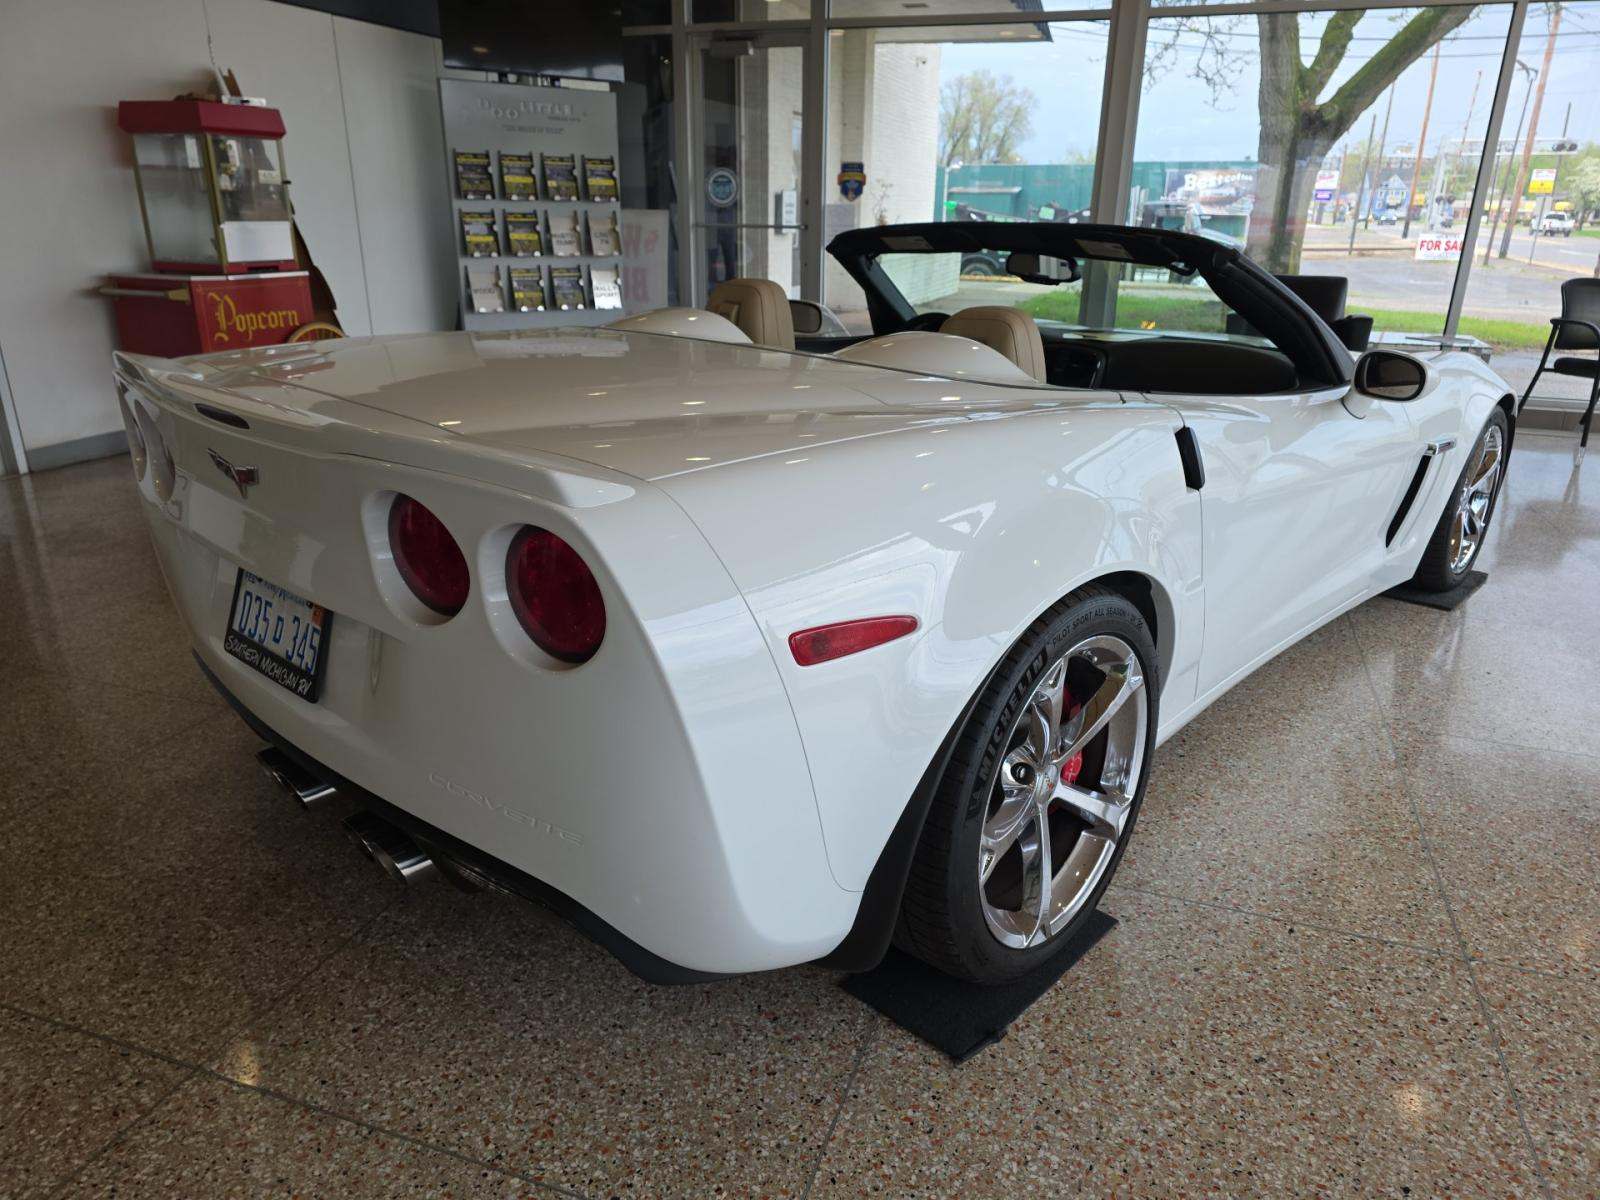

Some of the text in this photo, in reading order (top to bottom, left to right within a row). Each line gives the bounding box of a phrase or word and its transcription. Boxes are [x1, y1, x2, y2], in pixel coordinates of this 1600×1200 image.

[1420, 240, 1464, 252] FOR SAL
[208, 292, 300, 342] Popcorn
[239, 590, 273, 645] 035
[286, 616, 321, 673] 345
[1052, 623, 1072, 648] PILOT
[1094, 606, 1105, 618] ALL
[225, 635, 312, 695] SOUTHERN MICHIGAN RV
[979, 649, 1048, 781] MICHELIN
[426, 770, 585, 848] CORVETTE
